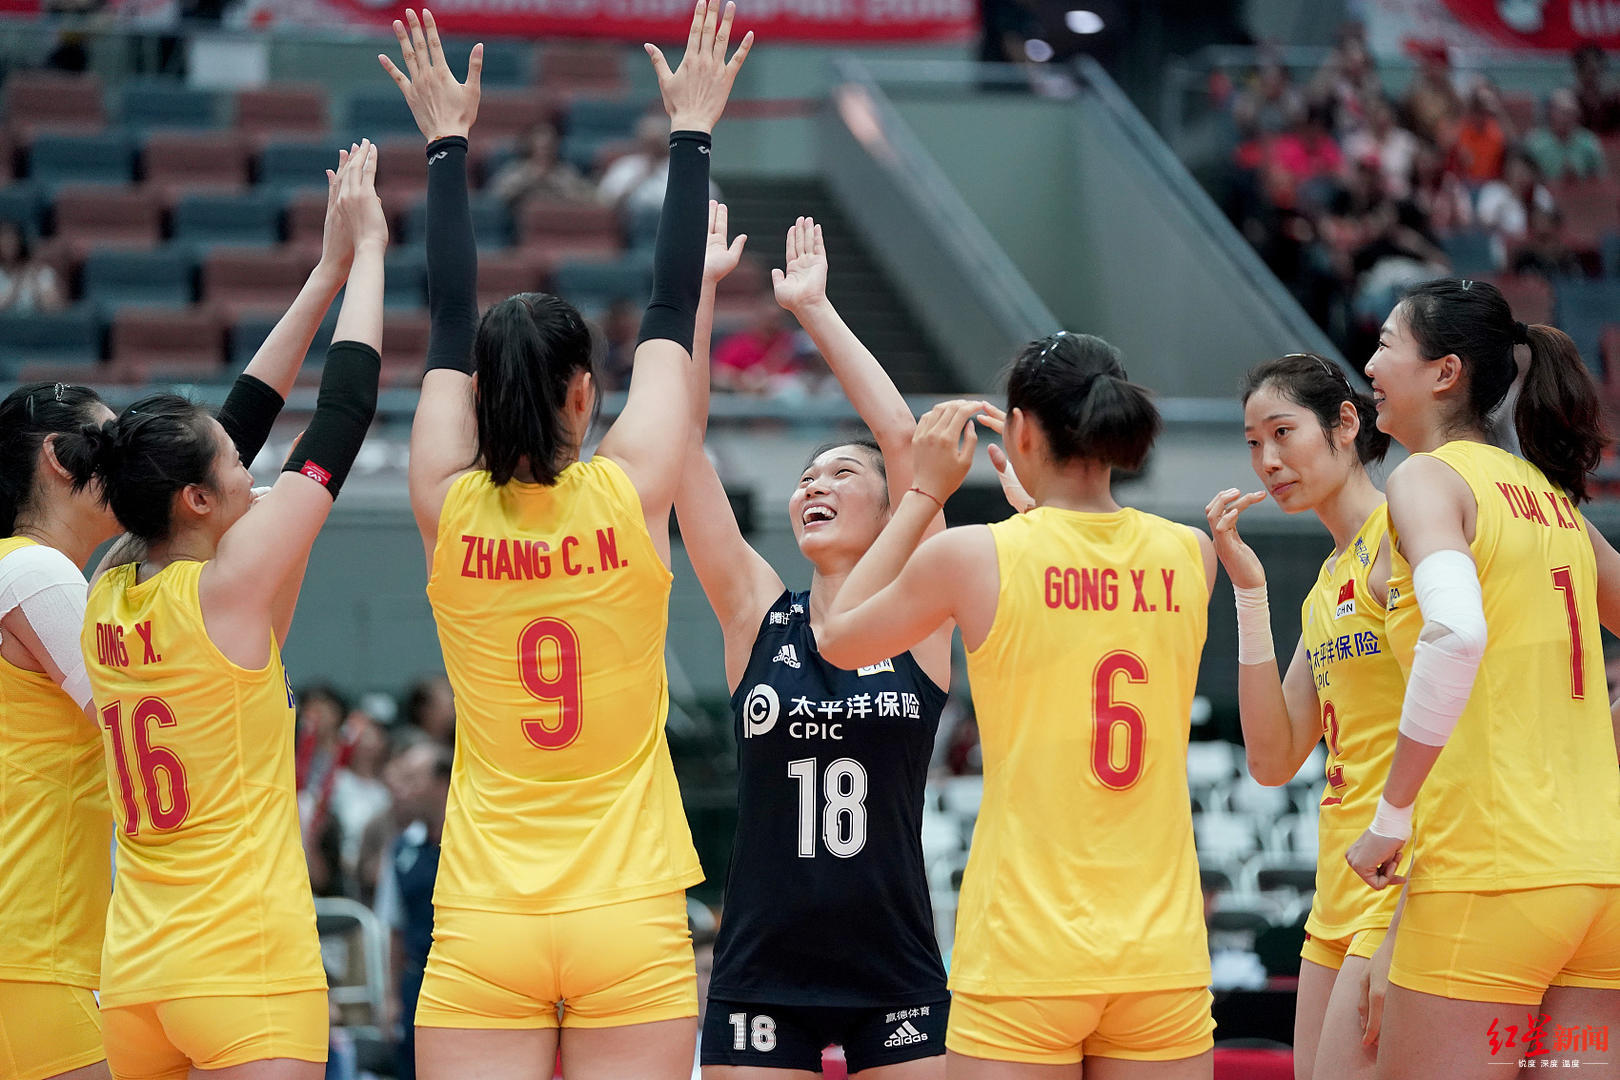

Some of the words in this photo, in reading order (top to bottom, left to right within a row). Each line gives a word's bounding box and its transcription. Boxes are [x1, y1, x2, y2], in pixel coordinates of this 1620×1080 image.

[461, 534, 552, 581] ZHANG
[1044, 566, 1119, 612] GONG
[1336, 603, 1353, 617] CHN
[96, 622, 129, 667] DING
[135, 620, 162, 665] X.
[1550, 565, 1585, 700] 1
[516, 616, 583, 751] 9
[788, 691, 921, 720] 太平洋保险
[788, 721, 844, 740] CPIC
[1090, 648, 1149, 792] 6
[101, 696, 191, 837] 16
[788, 757, 868, 858] 18
[729, 1012, 776, 1052] 18
[884, 1033, 928, 1048] adidas
